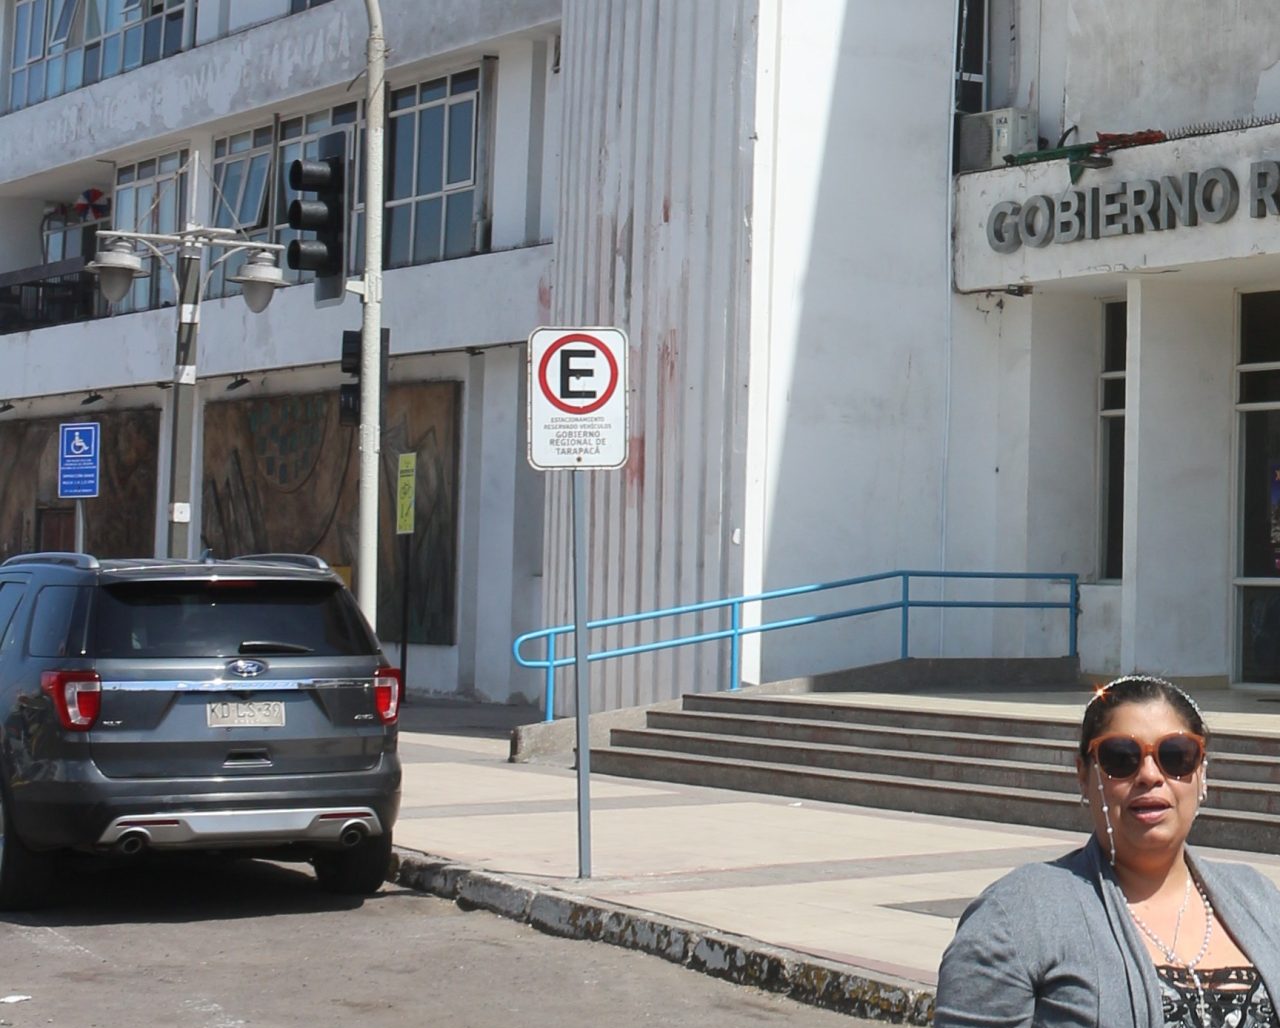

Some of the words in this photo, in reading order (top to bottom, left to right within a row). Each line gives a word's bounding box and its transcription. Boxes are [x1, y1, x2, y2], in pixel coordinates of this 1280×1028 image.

[986, 166, 1240, 255] GOBIERNO
[560, 349, 597, 399] E
[555, 430, 601, 439] GOBIERNO
[549, 438, 593, 446] REGIONAL
[595, 438, 607, 446] DE
[555, 446, 601, 455] TARAPACÁ
